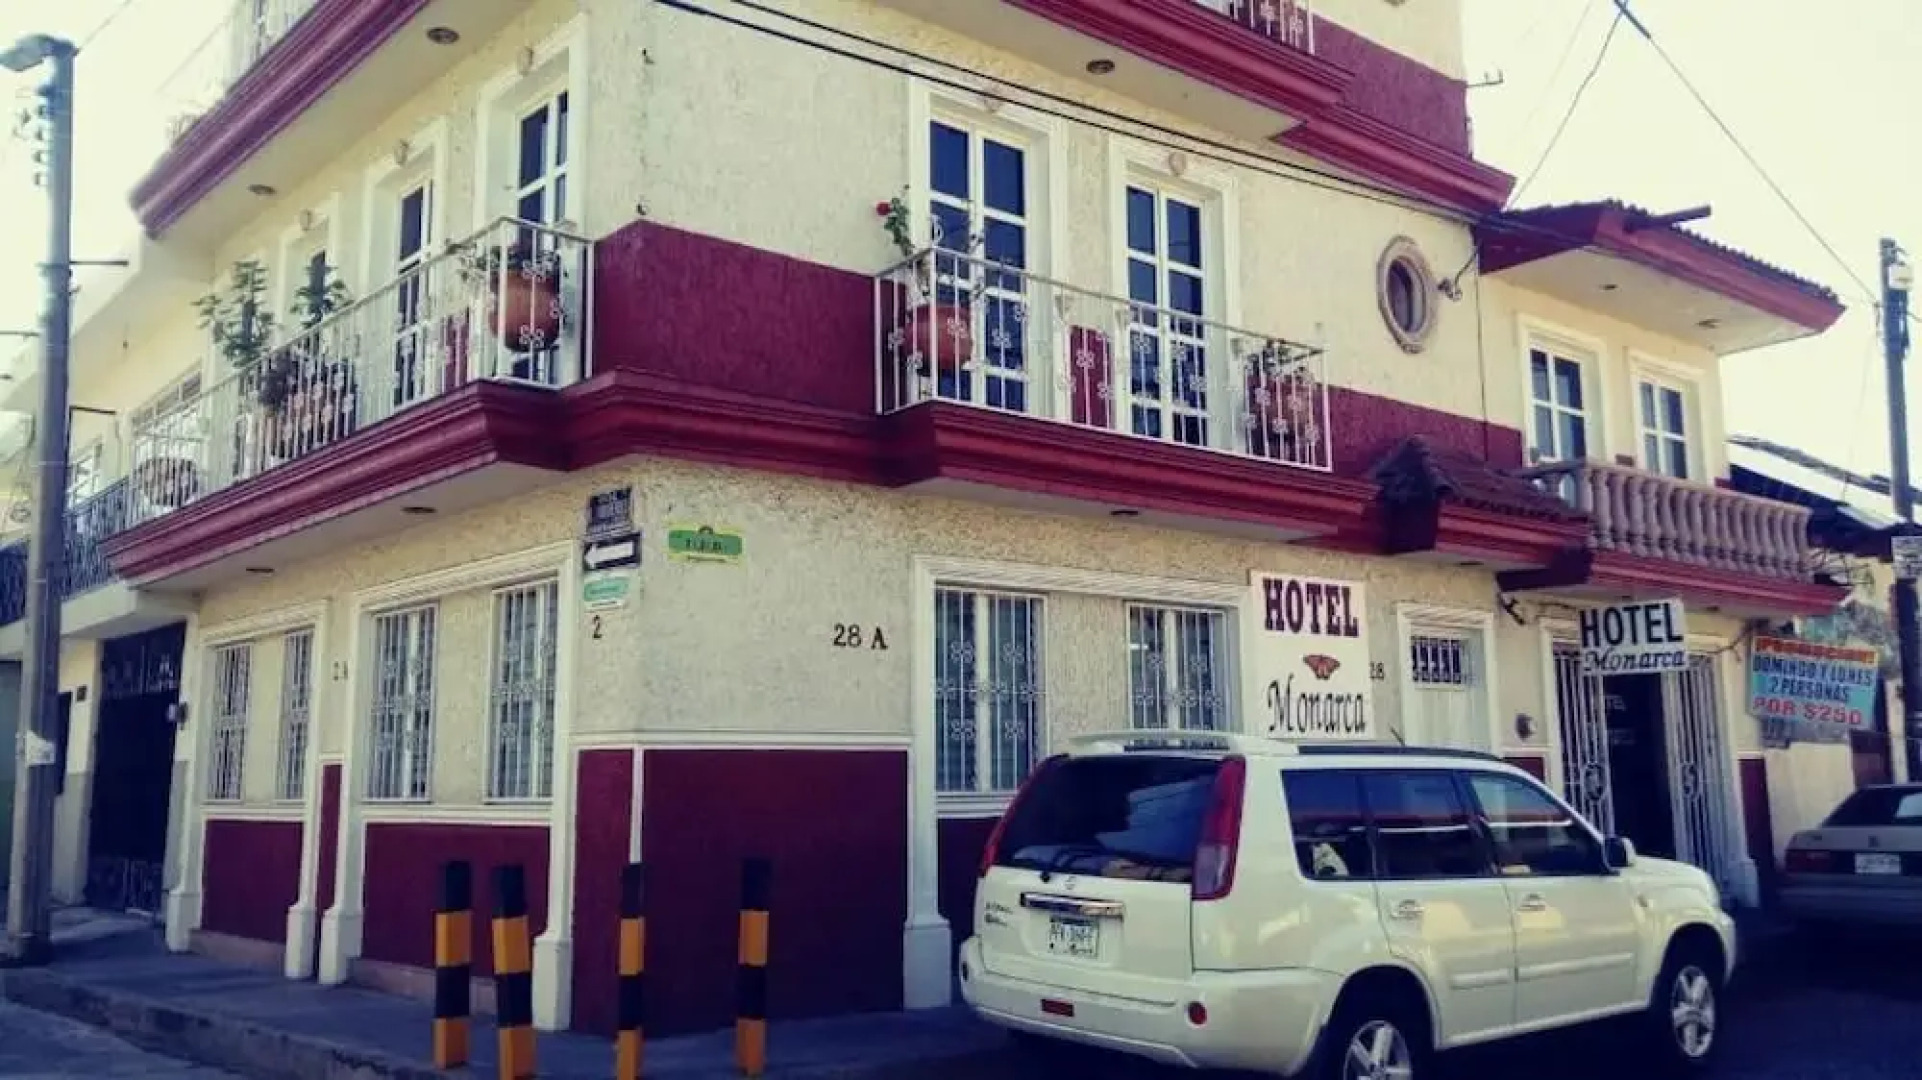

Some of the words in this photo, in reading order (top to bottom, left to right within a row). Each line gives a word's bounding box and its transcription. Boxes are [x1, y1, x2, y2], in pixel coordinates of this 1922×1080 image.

[1262, 578, 1359, 638] HOTEL
[593, 615, 603, 639] 2
[833, 623, 862, 648] 28
[870, 626, 889, 650] A
[1580, 602, 1684, 647] HOTEL
[1584, 648, 1685, 672] Monarca
[1754, 655, 1817, 679] DOMINGO
[1267, 672, 1366, 733] Monarca
